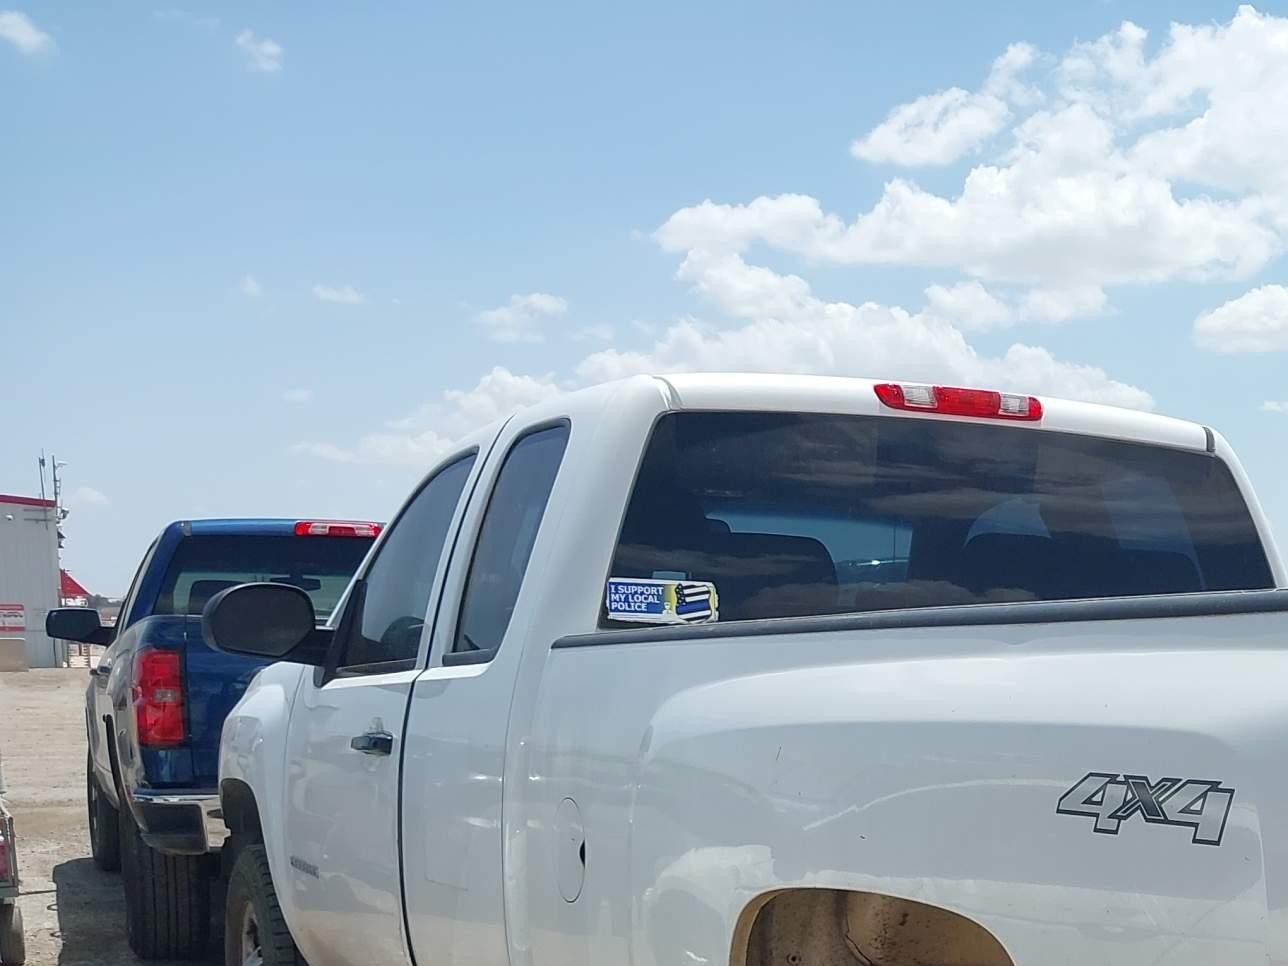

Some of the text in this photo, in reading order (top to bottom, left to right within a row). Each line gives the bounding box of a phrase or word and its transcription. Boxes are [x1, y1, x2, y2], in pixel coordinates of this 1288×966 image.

[611, 585, 664, 595] I SUPPORT
[611, 593, 660, 604] MY LOCAL
[611, 602, 648, 611] POLICE
